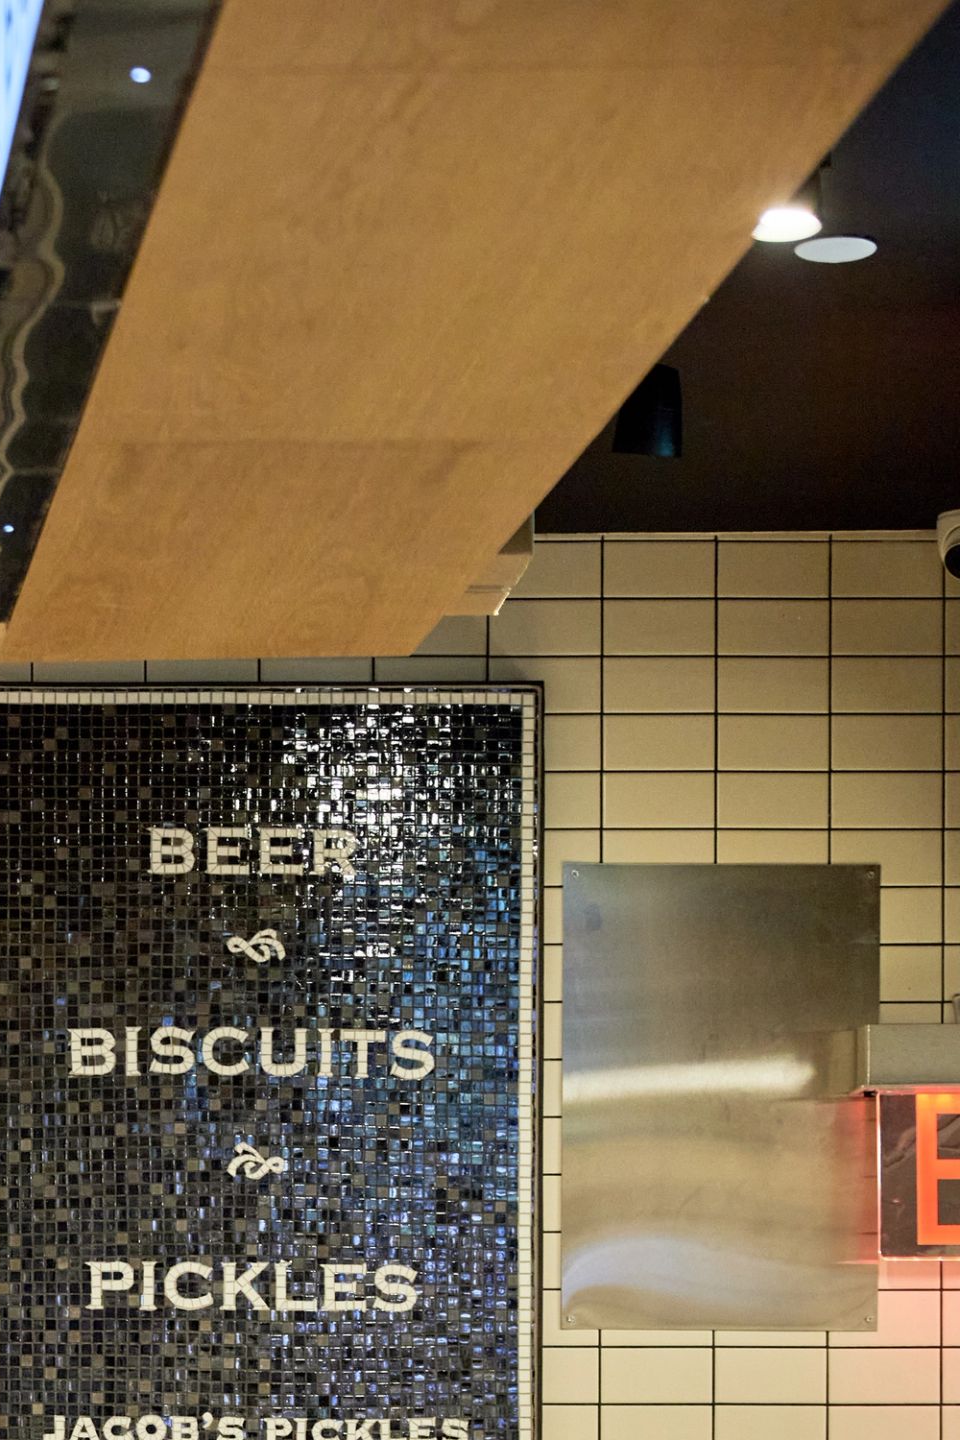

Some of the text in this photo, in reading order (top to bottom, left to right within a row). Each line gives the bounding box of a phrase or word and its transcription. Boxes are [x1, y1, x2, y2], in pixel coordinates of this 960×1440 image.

[147, 826, 356, 875] BEER
[67, 1026, 435, 1080] BISCUITS
[85, 1260, 418, 1312] PICKLES
